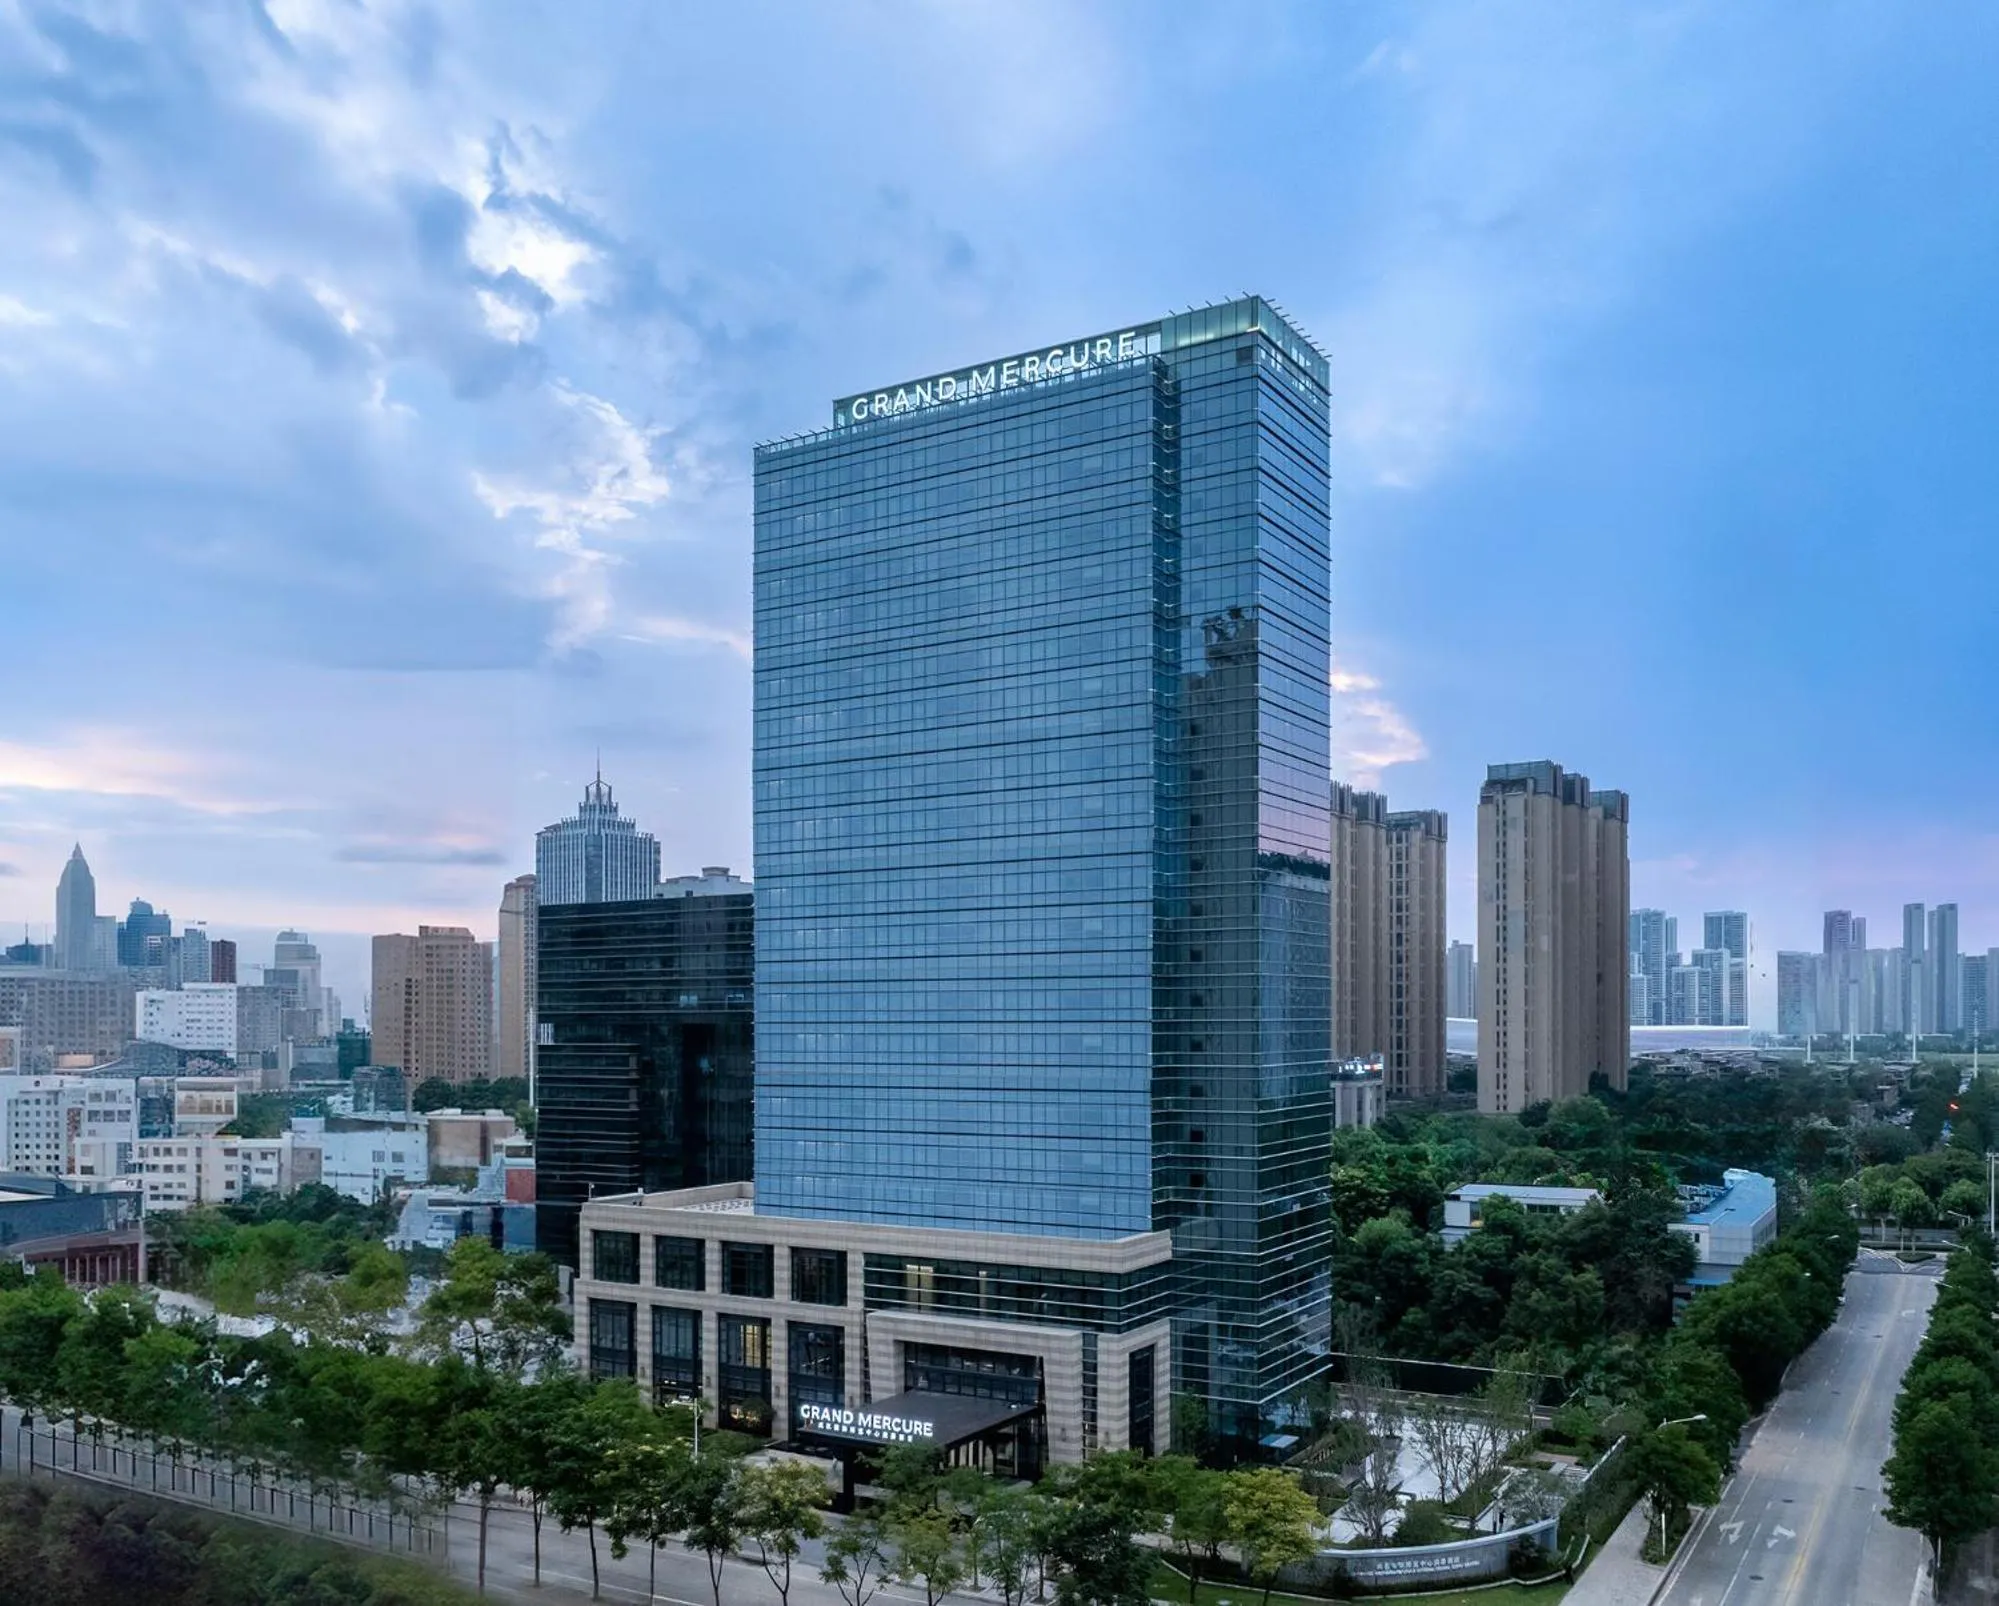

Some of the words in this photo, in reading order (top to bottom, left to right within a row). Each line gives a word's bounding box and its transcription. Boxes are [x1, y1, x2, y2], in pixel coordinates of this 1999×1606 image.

[852, 377, 956, 419] GRAND
[972, 331, 1136, 391] MERCURE
[800, 1404, 854, 1424] GRAND
[858, 1412, 934, 1437] MERCURE
